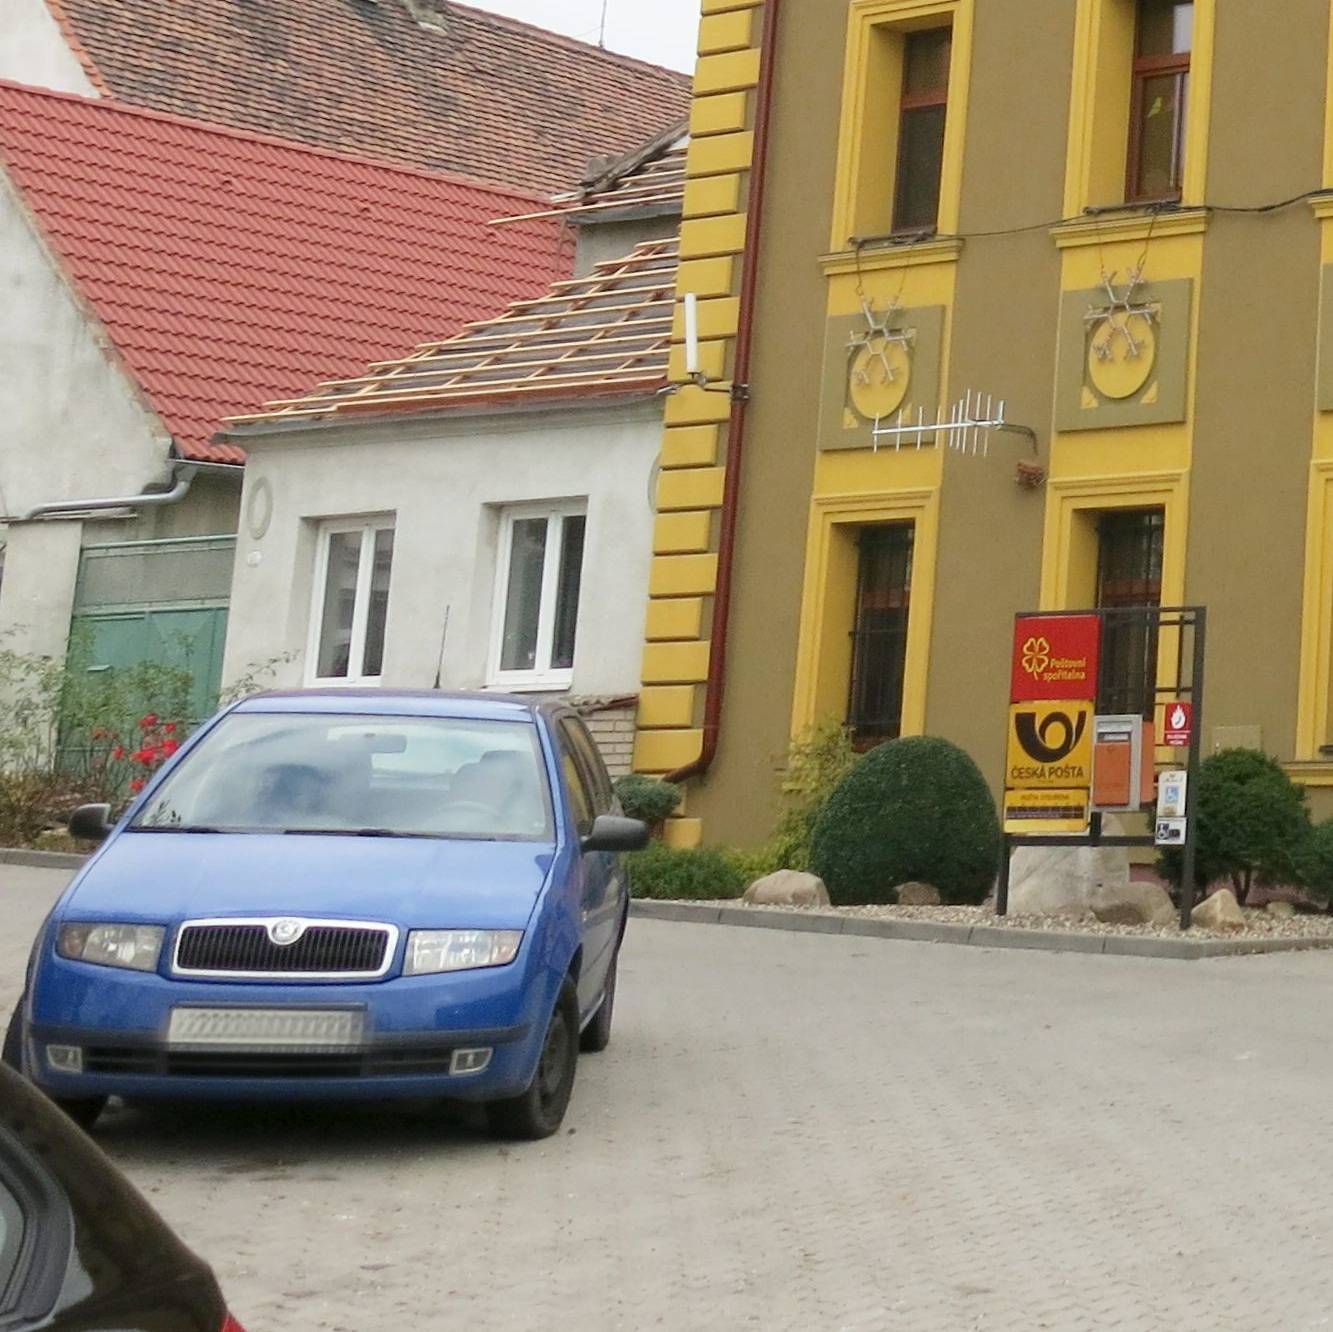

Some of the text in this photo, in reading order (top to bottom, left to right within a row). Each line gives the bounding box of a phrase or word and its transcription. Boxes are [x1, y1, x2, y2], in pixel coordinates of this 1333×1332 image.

[1050, 657, 1087, 669] Poštovní
[1043, 669, 1086, 682] spořitelna
[1011, 763, 1084, 779] ČESKÁ POŠTA
